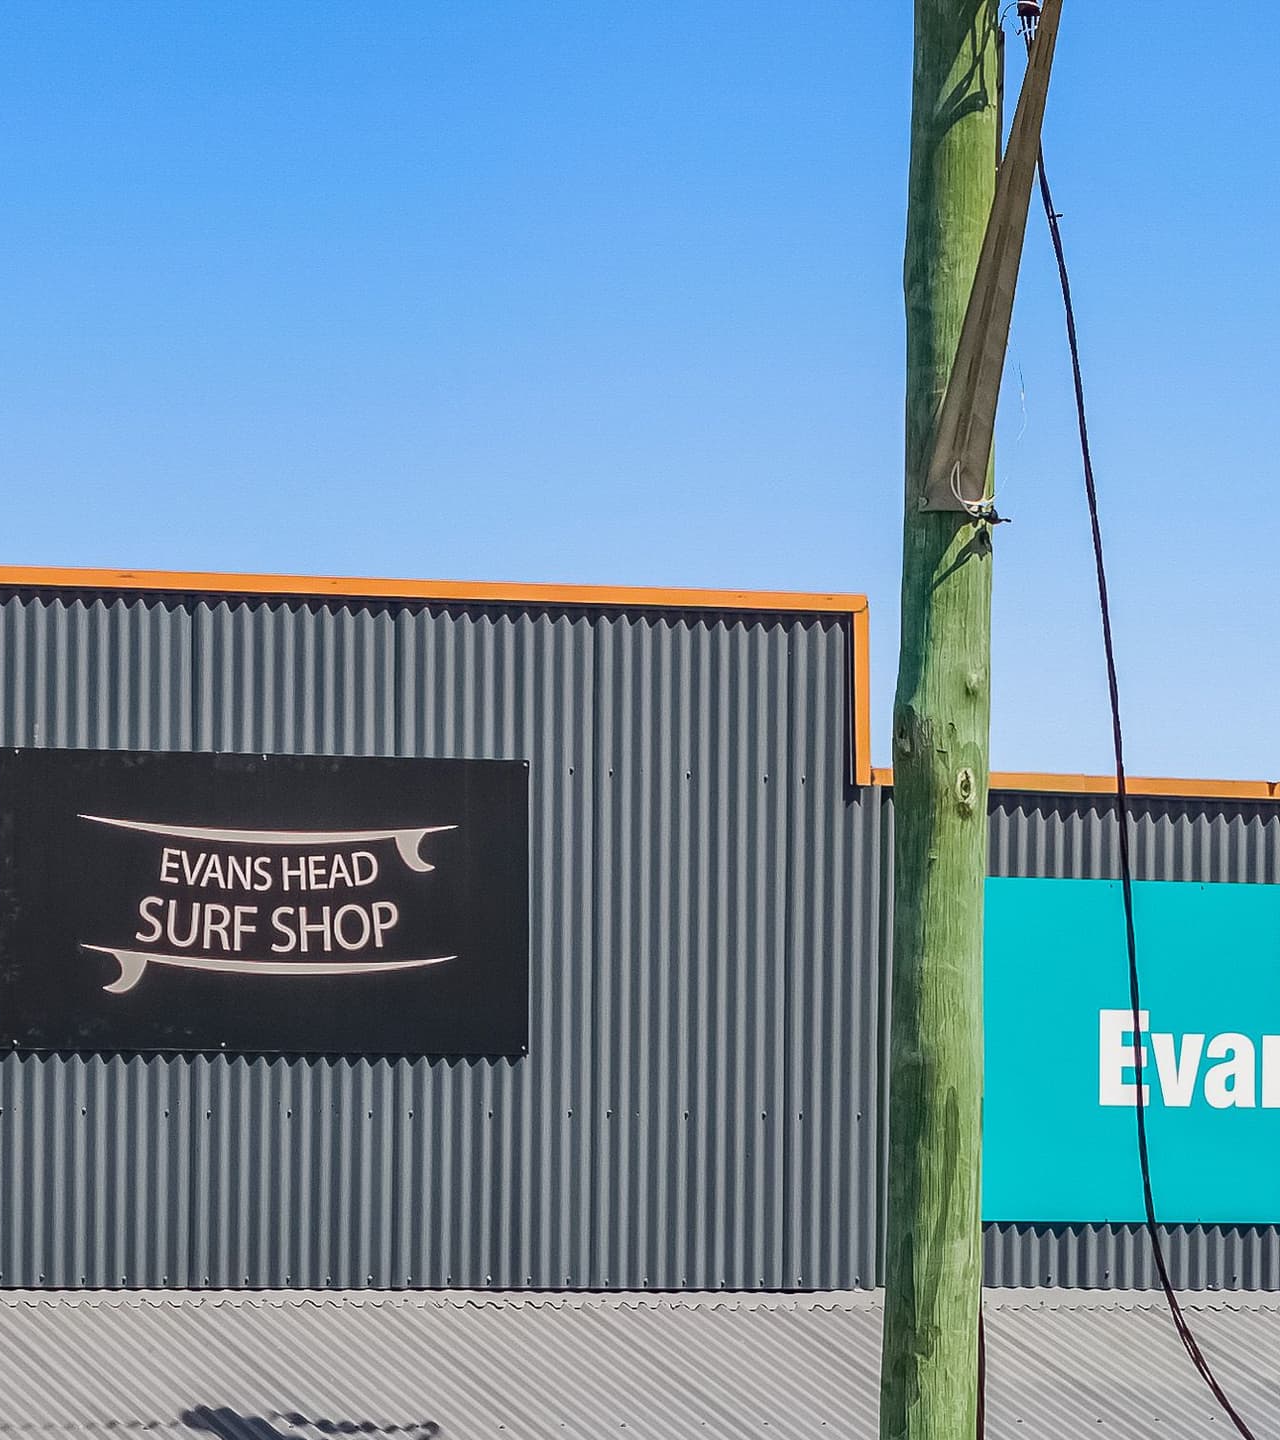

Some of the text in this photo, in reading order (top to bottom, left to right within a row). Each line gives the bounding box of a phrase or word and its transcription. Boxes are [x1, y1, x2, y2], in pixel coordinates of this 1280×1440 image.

[160, 847, 378, 891] EVANS HEAD
[135, 896, 398, 952] SURF SHOP
